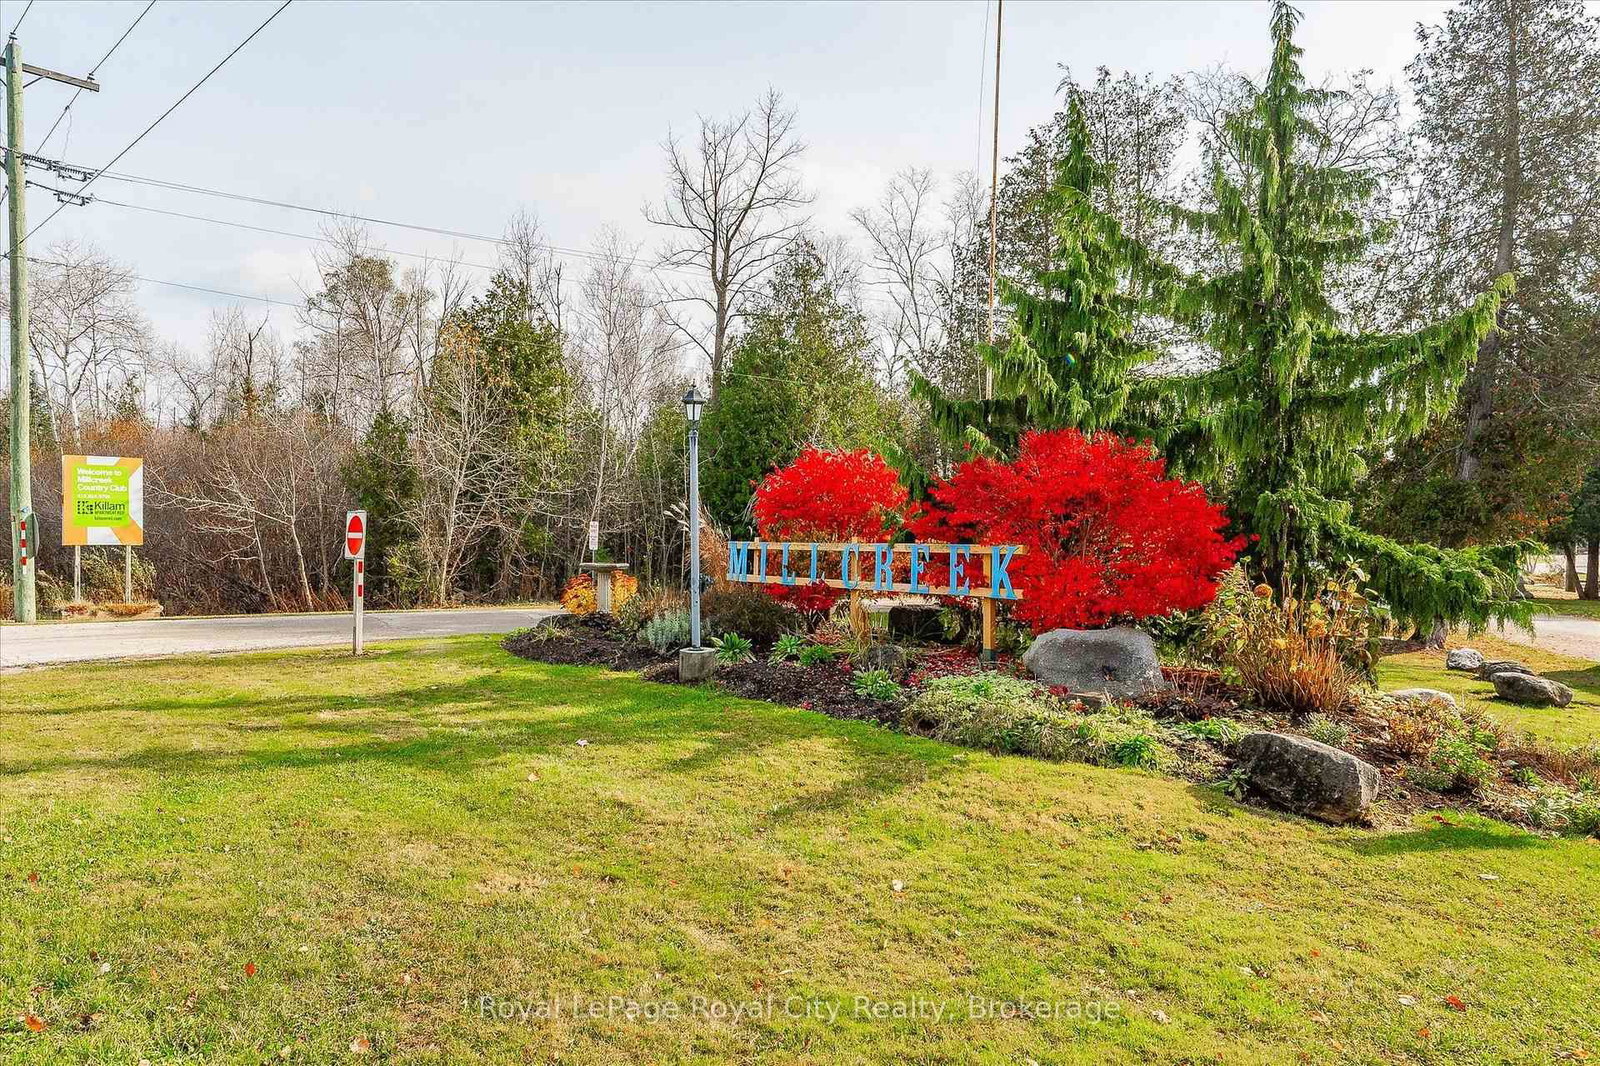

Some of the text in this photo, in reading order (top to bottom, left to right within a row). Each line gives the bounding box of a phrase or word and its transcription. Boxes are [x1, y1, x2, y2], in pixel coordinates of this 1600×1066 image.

[77, 467, 122, 477] Welcome to
[77, 476, 112, 484] Millcreek
[77, 484, 109, 493] Country
[94, 501, 126, 511] Killam
